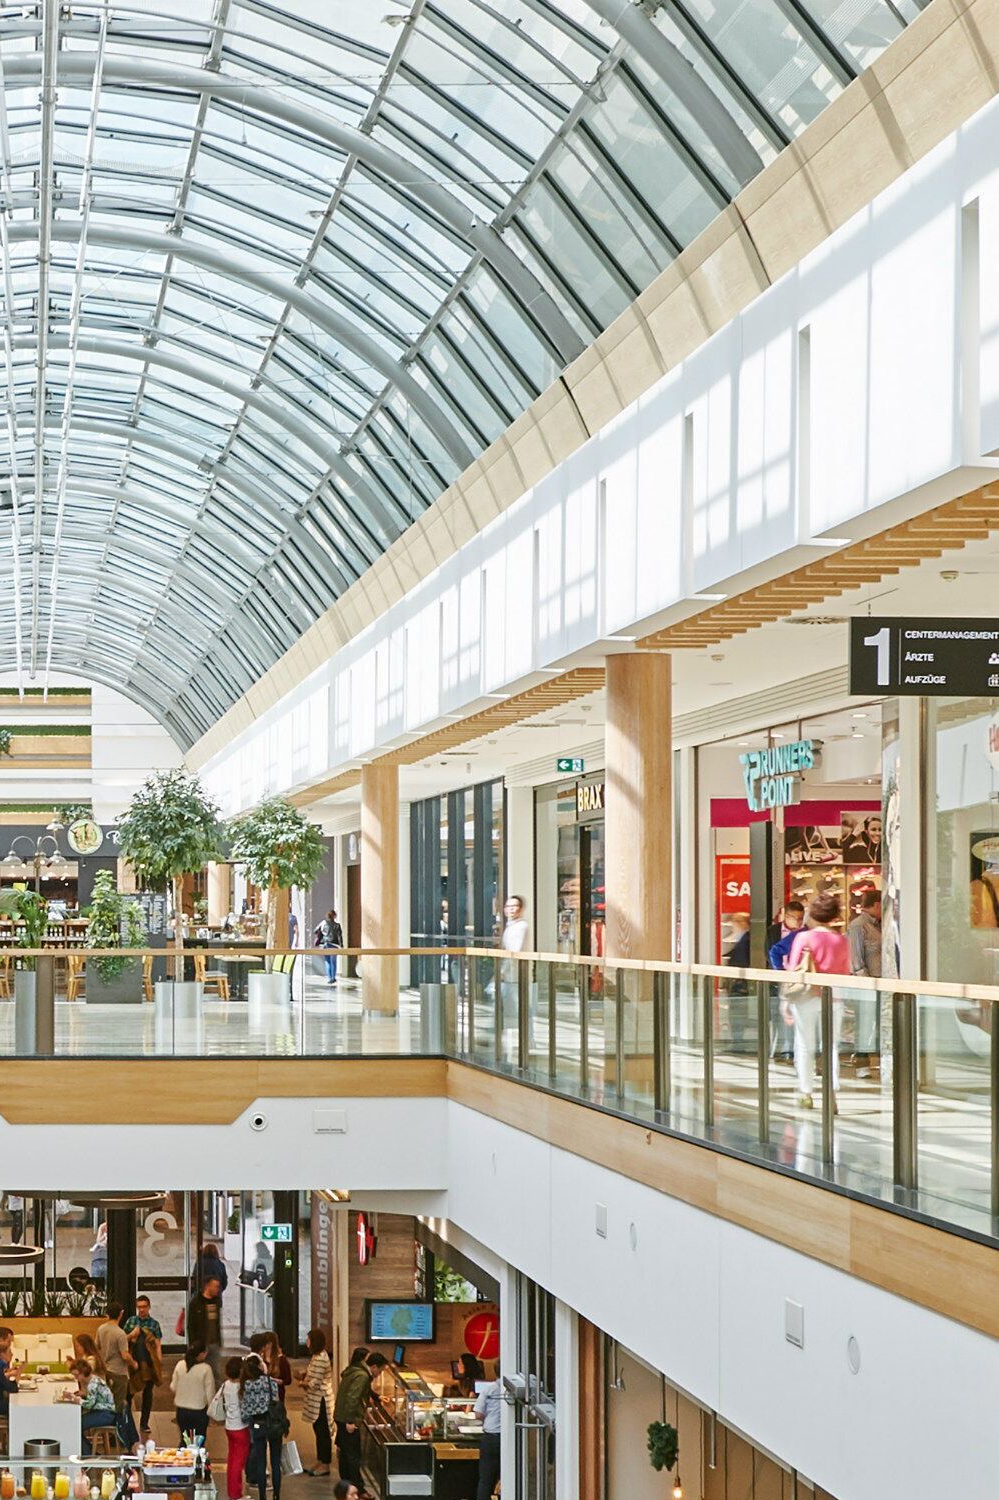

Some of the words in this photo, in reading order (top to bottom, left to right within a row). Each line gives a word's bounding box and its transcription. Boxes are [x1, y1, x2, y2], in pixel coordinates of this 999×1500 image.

[904, 630, 999, 640] CENTERMANAGEMENT
[864, 628, 890, 686] 1
[904, 651, 934, 662] ÄRZTE
[904, 674, 946, 684] AUFZÜGE
[759, 739, 814, 777] RUNNERS
[577, 783, 602, 812] BRAX
[760, 776, 794, 808] POINT
[726, 881, 751, 897] SA
[317, 1201, 330, 1328] Traublinge
